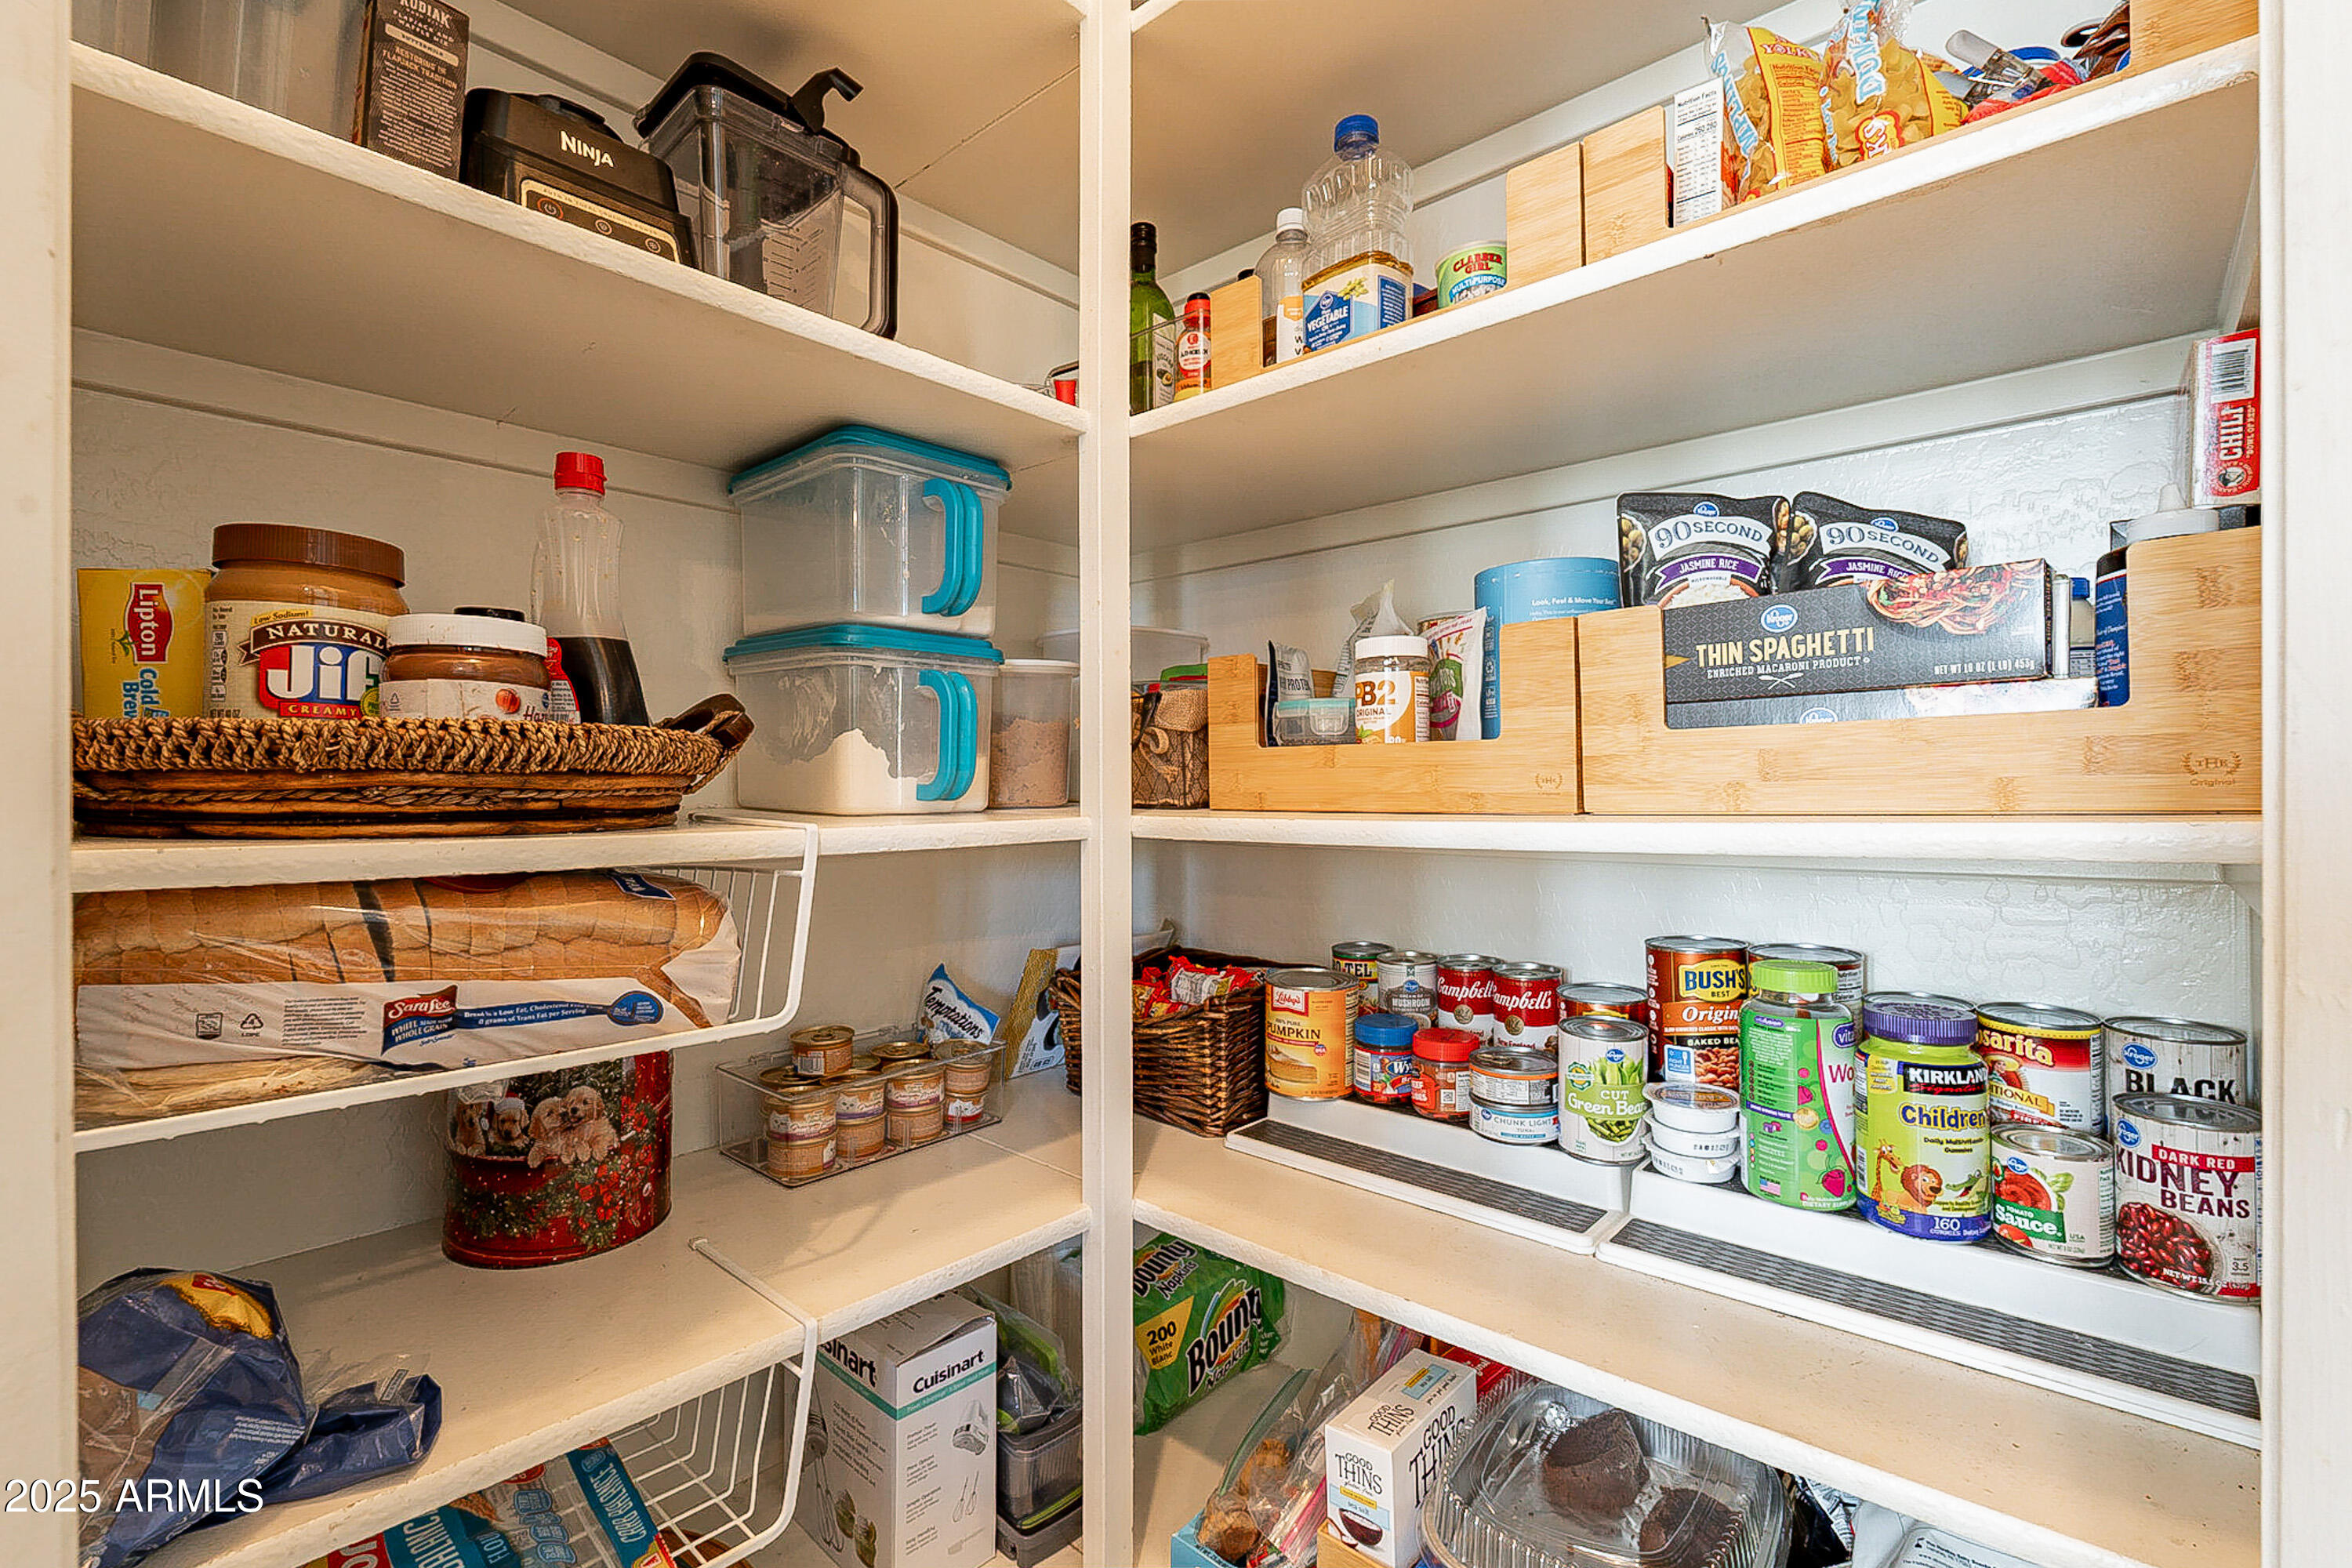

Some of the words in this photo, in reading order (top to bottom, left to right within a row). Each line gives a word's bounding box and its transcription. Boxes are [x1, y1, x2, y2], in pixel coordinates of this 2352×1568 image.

[560, 130, 614, 167] NINJA
[1453, 252, 1503, 273] CLABBER
[1465, 262, 1493, 274] GIRL
[1308, 306, 1348, 332] VEGETABLE
[1654, 521, 1692, 548] 90
[1693, 521, 1762, 543] SECOND
[1826, 526, 1865, 545] 90
[1867, 530, 1940, 563] SECOND
[1679, 558, 1716, 574] JASMINE
[1719, 558, 1740, 571] RICE
[1846, 561, 1885, 575] JASMINE
[133, 589, 159, 656] Lipton
[274, 610, 309, 619] Sodium!
[1766, 609, 1794, 627] Kroger
[266, 623, 386, 650] NATURAL
[1696, 641, 1743, 666] THIN
[1748, 626, 1875, 663] SPAGHETTI
[267, 644, 384, 702] Jif
[1707, 666, 1754, 679] ENRICHED
[1756, 662, 1810, 674] MACARONI
[1813, 656, 1860, 670] PRODUCT
[139, 668, 161, 705] Cold
[1355, 680, 1396, 707] PB2
[288, 704, 358, 717] CREAMY
[1356, 707, 1392, 717] ORIGINAL
[1684, 968, 1746, 991] BUSH'S
[388, 1002, 427, 1018] Sara
[426, 998, 456, 1014] Lee
[1275, 990, 1301, 1005] Libby's
[1392, 998, 1431, 1007] MUSHROOM
[485, 1017, 506, 1026] grams
[517, 1012, 535, 1022] Trans
[536, 1011, 548, 1020] Fat
[549, 1011, 561, 1020] per
[561, 1008, 586, 1018] Serving
[499, 1008, 514, 1017] Low
[516, 1007, 528, 1015] Fat,
[529, 1003, 569, 1011] Cholesterol
[924, 985, 985, 1040] Temptations
[392, 1019, 418, 1036] WHITE
[394, 1029, 423, 1043] WHOLE
[423, 1022, 448, 1035] GRAIN
[1267, 1021, 1321, 1040] PUMPKIN
[1687, 1038, 1722, 1047] BAKED
[2124, 1046, 2157, 1065] Kroger
[1600, 1090, 1629, 1100] CUT
[2125, 1068, 2237, 1105] BLACK
[1568, 1092, 1615, 1115] Green
[1494, 1116, 1526, 1127] CHUNK
[1901, 1105, 1985, 1129] Children
[2158, 1149, 2201, 1167] DARK
[2205, 1156, 2236, 1170] RED
[2116, 1147, 2240, 1198] KIDNEY
[2006, 1205, 2034, 1218] TOMATO
[2161, 1189, 2251, 1219] BEANS
[1933, 1217, 1961, 1230] 160
[1995, 1203, 2057, 1235] Sauce
[2162, 1267, 2180, 1279] NET
[2231, 1261, 2249, 1271] 3.5
[1156, 1260, 1200, 1301] Napkins
[1147, 1321, 1176, 1345] 200
[1149, 1341, 1174, 1356] White
[1151, 1351, 1173, 1366] Blanc
[913, 1348, 985, 1394] Cuisinart
[1367, 1404, 1414, 1436] THINS
[1370, 1404, 1392, 1423] GOOD
[1423, 1405, 1456, 1450] GOOD
[1345, 1452, 1374, 1471] GOOD
[1334, 1454, 1383, 1494] THINS
[590, 1462, 634, 1517] BALANCE
[610, 1510, 647, 1544] CARB
[402, 1509, 467, 1568] ALANC
